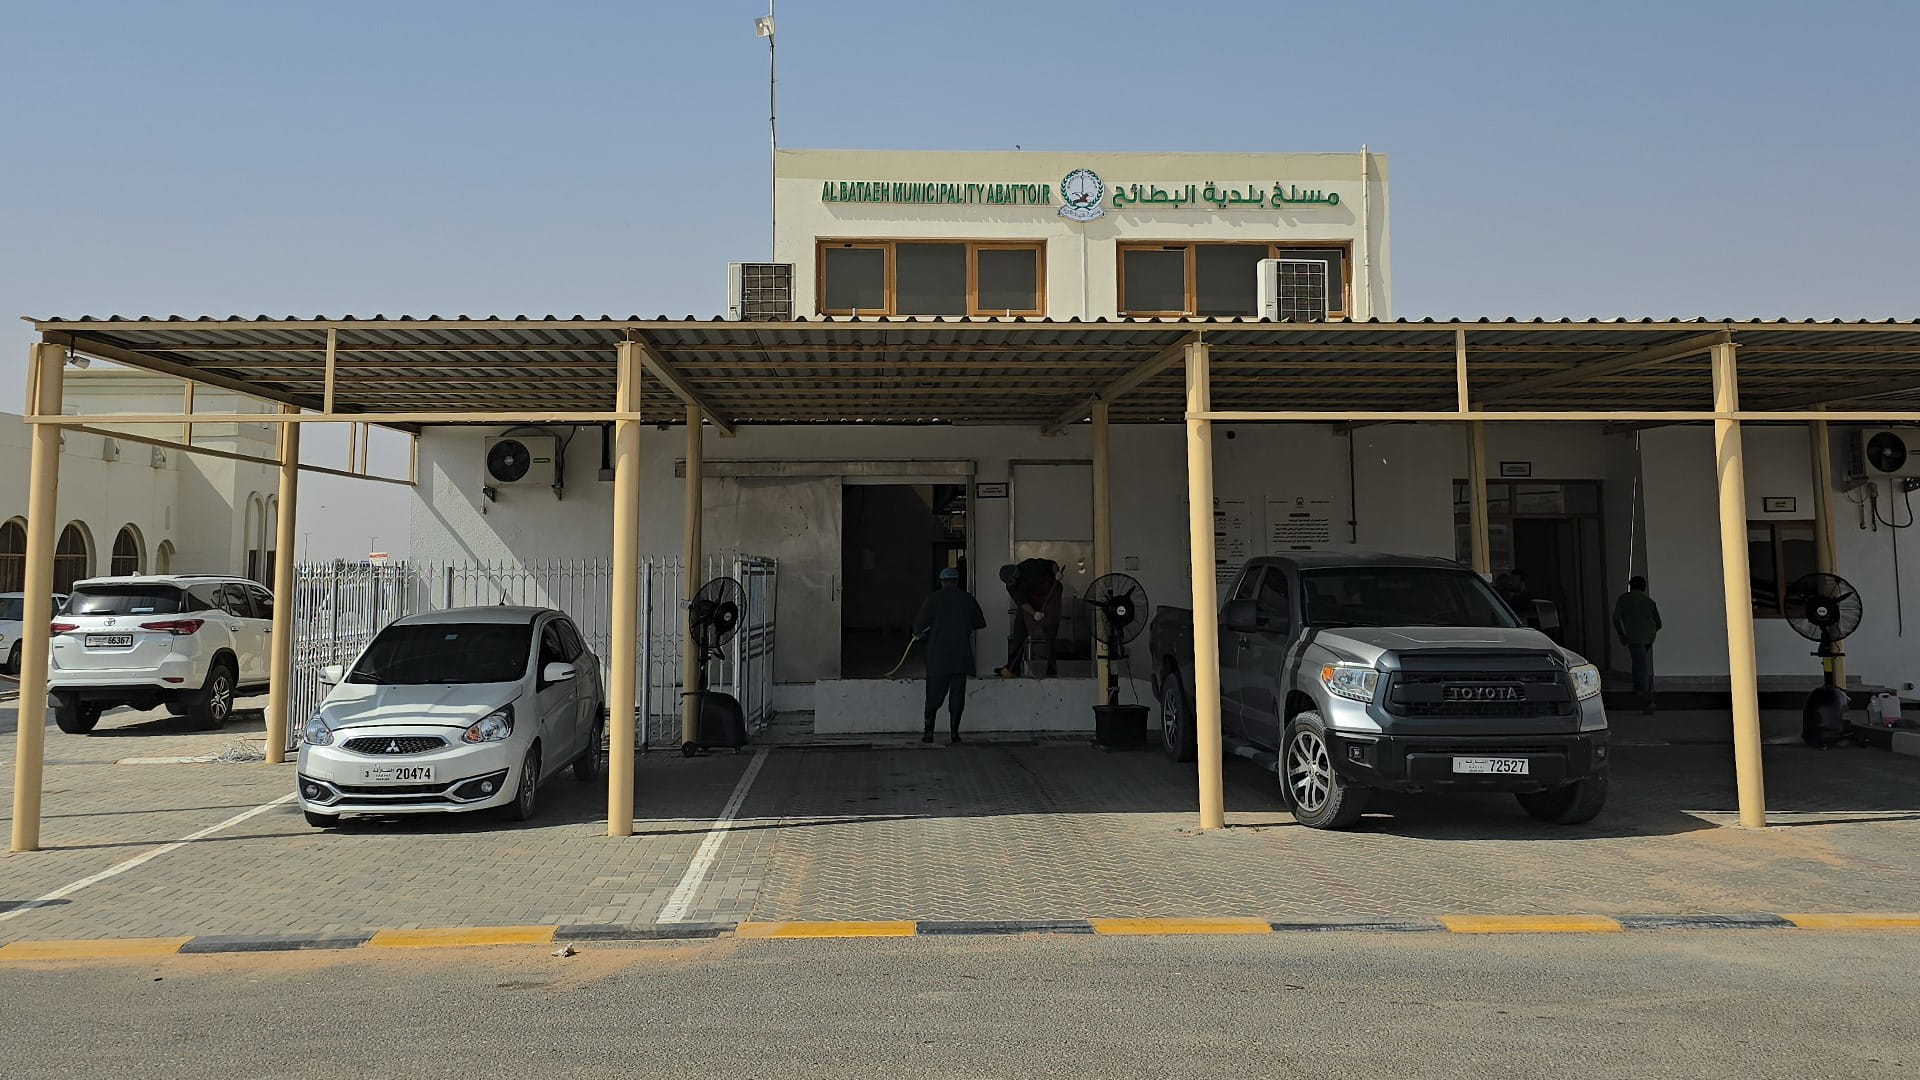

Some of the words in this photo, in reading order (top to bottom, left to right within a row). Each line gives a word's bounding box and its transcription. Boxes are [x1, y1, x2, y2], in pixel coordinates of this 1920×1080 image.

[821, 181, 838, 202] AL
[839, 181, 890, 203] BATAEH
[892, 182, 985, 204] MUNICIPALITY
[986, 183, 1051, 205] ABATTOIR
[1112, 183, 1196, 209] البطائح
[1202, 181, 1265, 209] بلدية
[1270, 181, 1341, 209] مسلخ
[1450, 686, 1518, 699] TOYOTA
[395, 767, 431, 780] 20474
[1489, 759, 1526, 773] 72527
